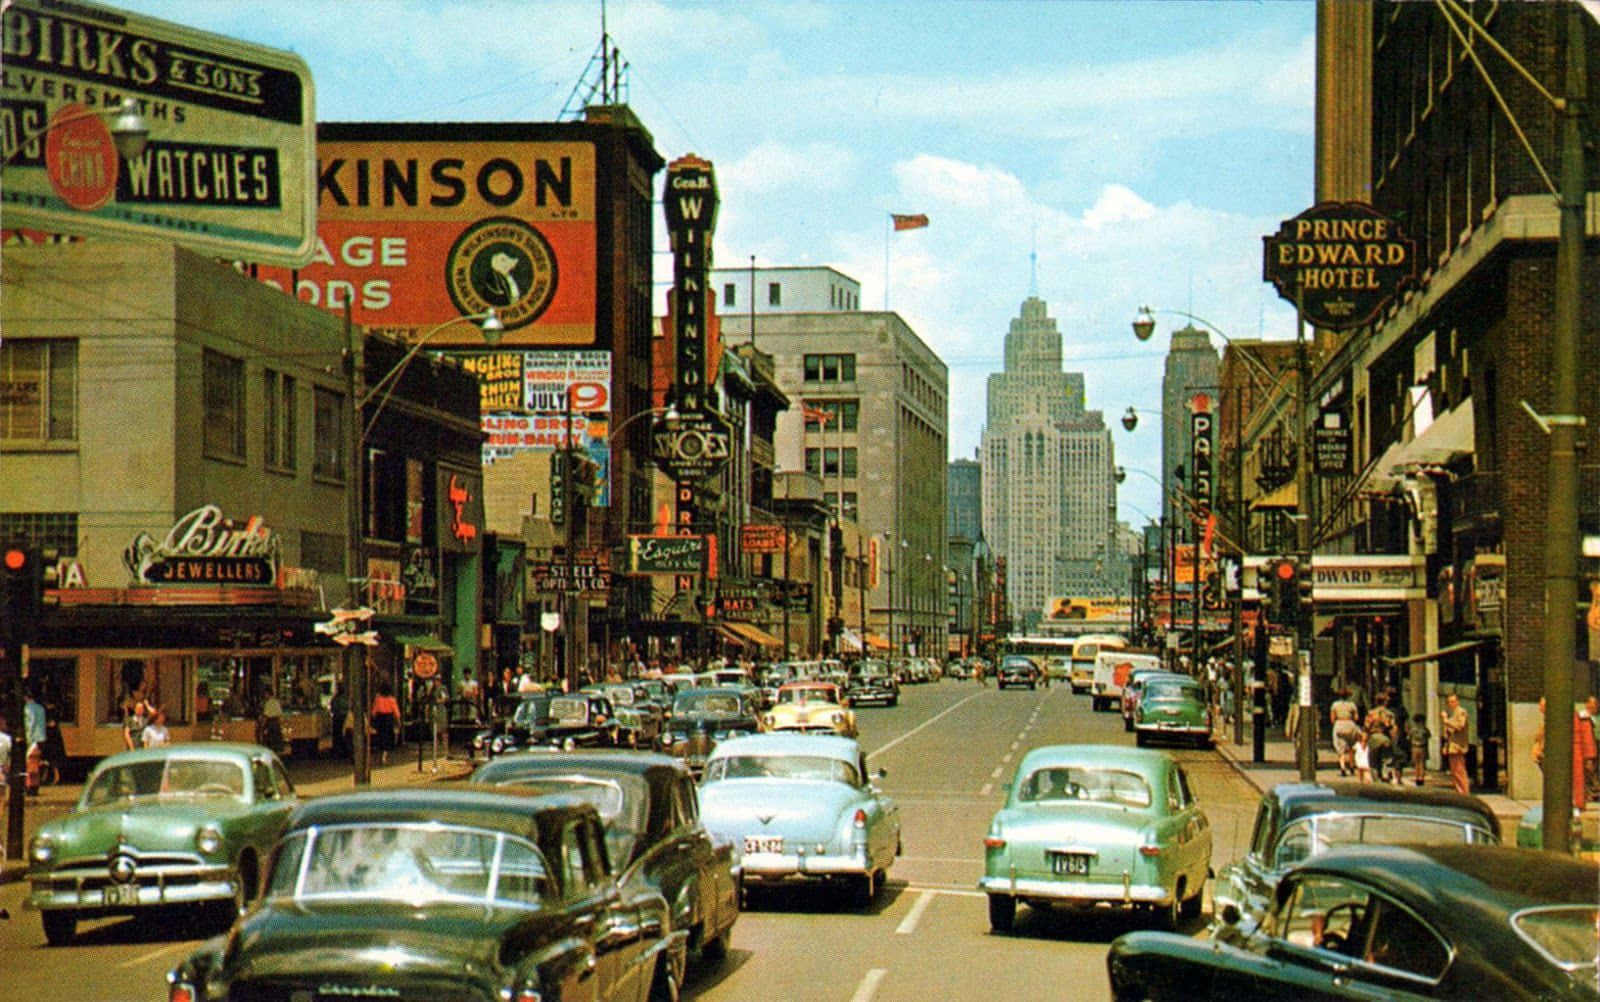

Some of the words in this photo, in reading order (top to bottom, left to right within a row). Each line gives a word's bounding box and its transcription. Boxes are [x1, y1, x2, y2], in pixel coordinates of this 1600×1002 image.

[2, 14, 158, 84] BIRKS
[169, 59, 187, 81] &
[195, 62, 264, 97] SONS
[127, 148, 271, 200] WATCHES
[317, 156, 572, 207] KINSON
[1296, 219, 1388, 241] PRINCE
[1279, 244, 1406, 265] EDWARD
[1303, 268, 1380, 289] HOTEL
[527, 393, 565, 410] JULY
[569, 382, 607, 410] 9
[164, 560, 262, 580] JEWELLERS
[1317, 569, 1372, 583] DWARD
